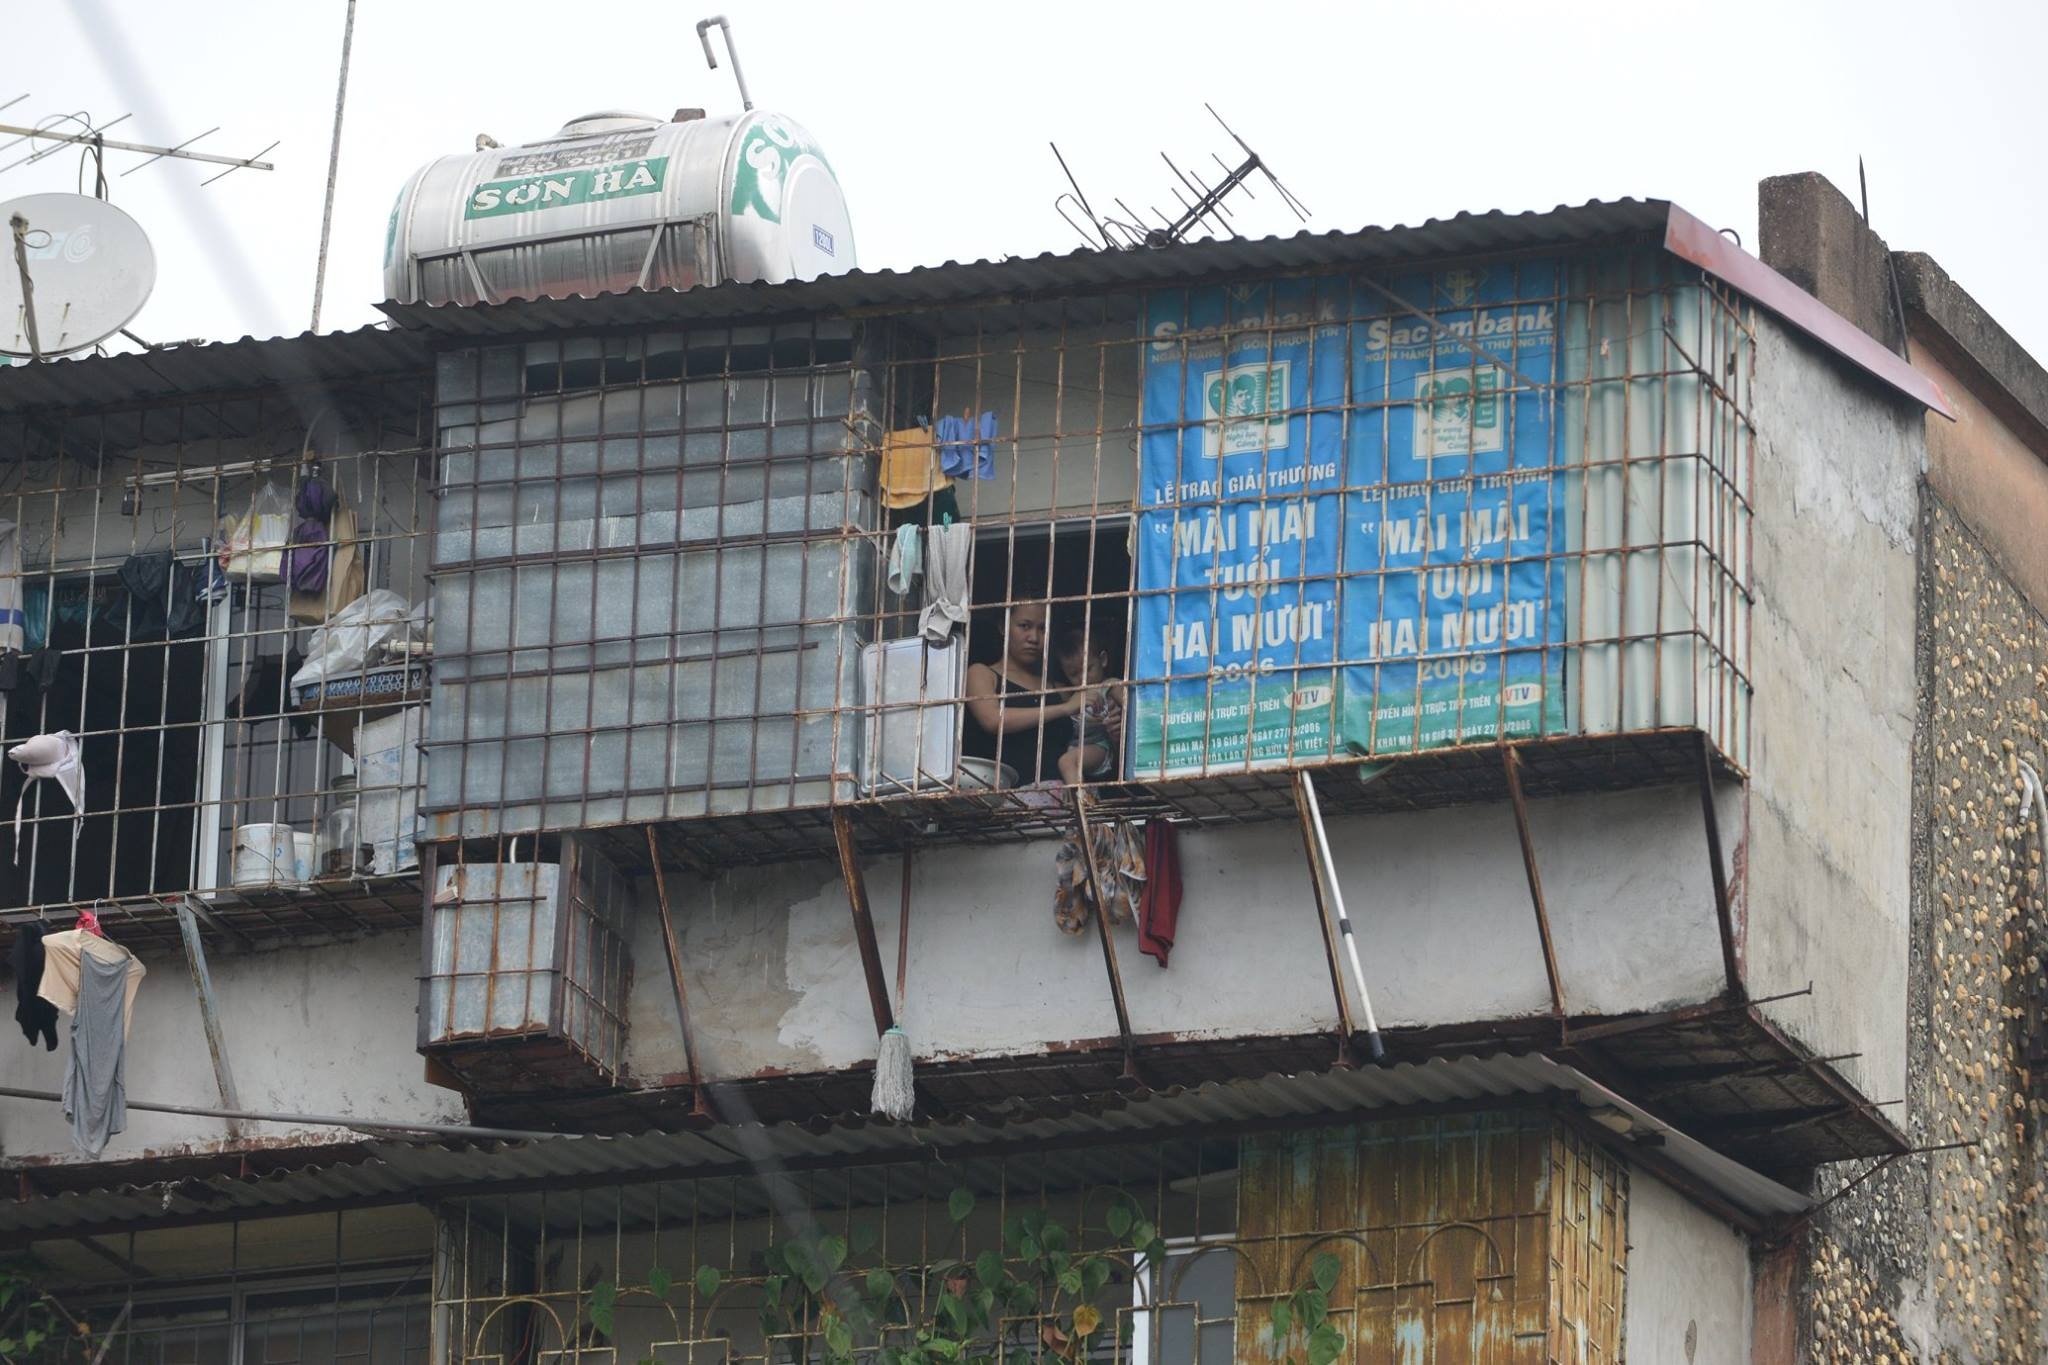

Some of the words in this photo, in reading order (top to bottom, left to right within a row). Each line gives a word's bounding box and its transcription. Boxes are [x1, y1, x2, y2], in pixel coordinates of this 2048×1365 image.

[510, 161, 558, 175] ISO
[567, 149, 633, 166] 9001
[471, 177, 576, 211] SƠN
[590, 161, 657, 195] HÀ
[1152, 300, 1336, 351] Sacmbak
[1487, 335, 1537, 350] THƯNG
[1155, 481, 1174, 504] LỄ
[1205, 546, 1281, 604] TUỔI
[1413, 546, 1492, 602] TUỔI
[1162, 619, 1219, 662] HAI
[1369, 617, 1429, 658] HAI
[1211, 657, 1275, 685] 2006
[1421, 655, 1487, 681] 2006
[1259, 697, 1280, 713] TRÊN
[1469, 694, 1491, 709] TRÊN
[1169, 741, 1190, 754] KHAI
[1191, 740, 1208, 752] MẠ
[1242, 746, 1264, 758] ĐNG
[1284, 740, 1303, 753] NHỊ
[1376, 736, 1397, 748] KHAI
[1398, 735, 1416, 747] MẠ
